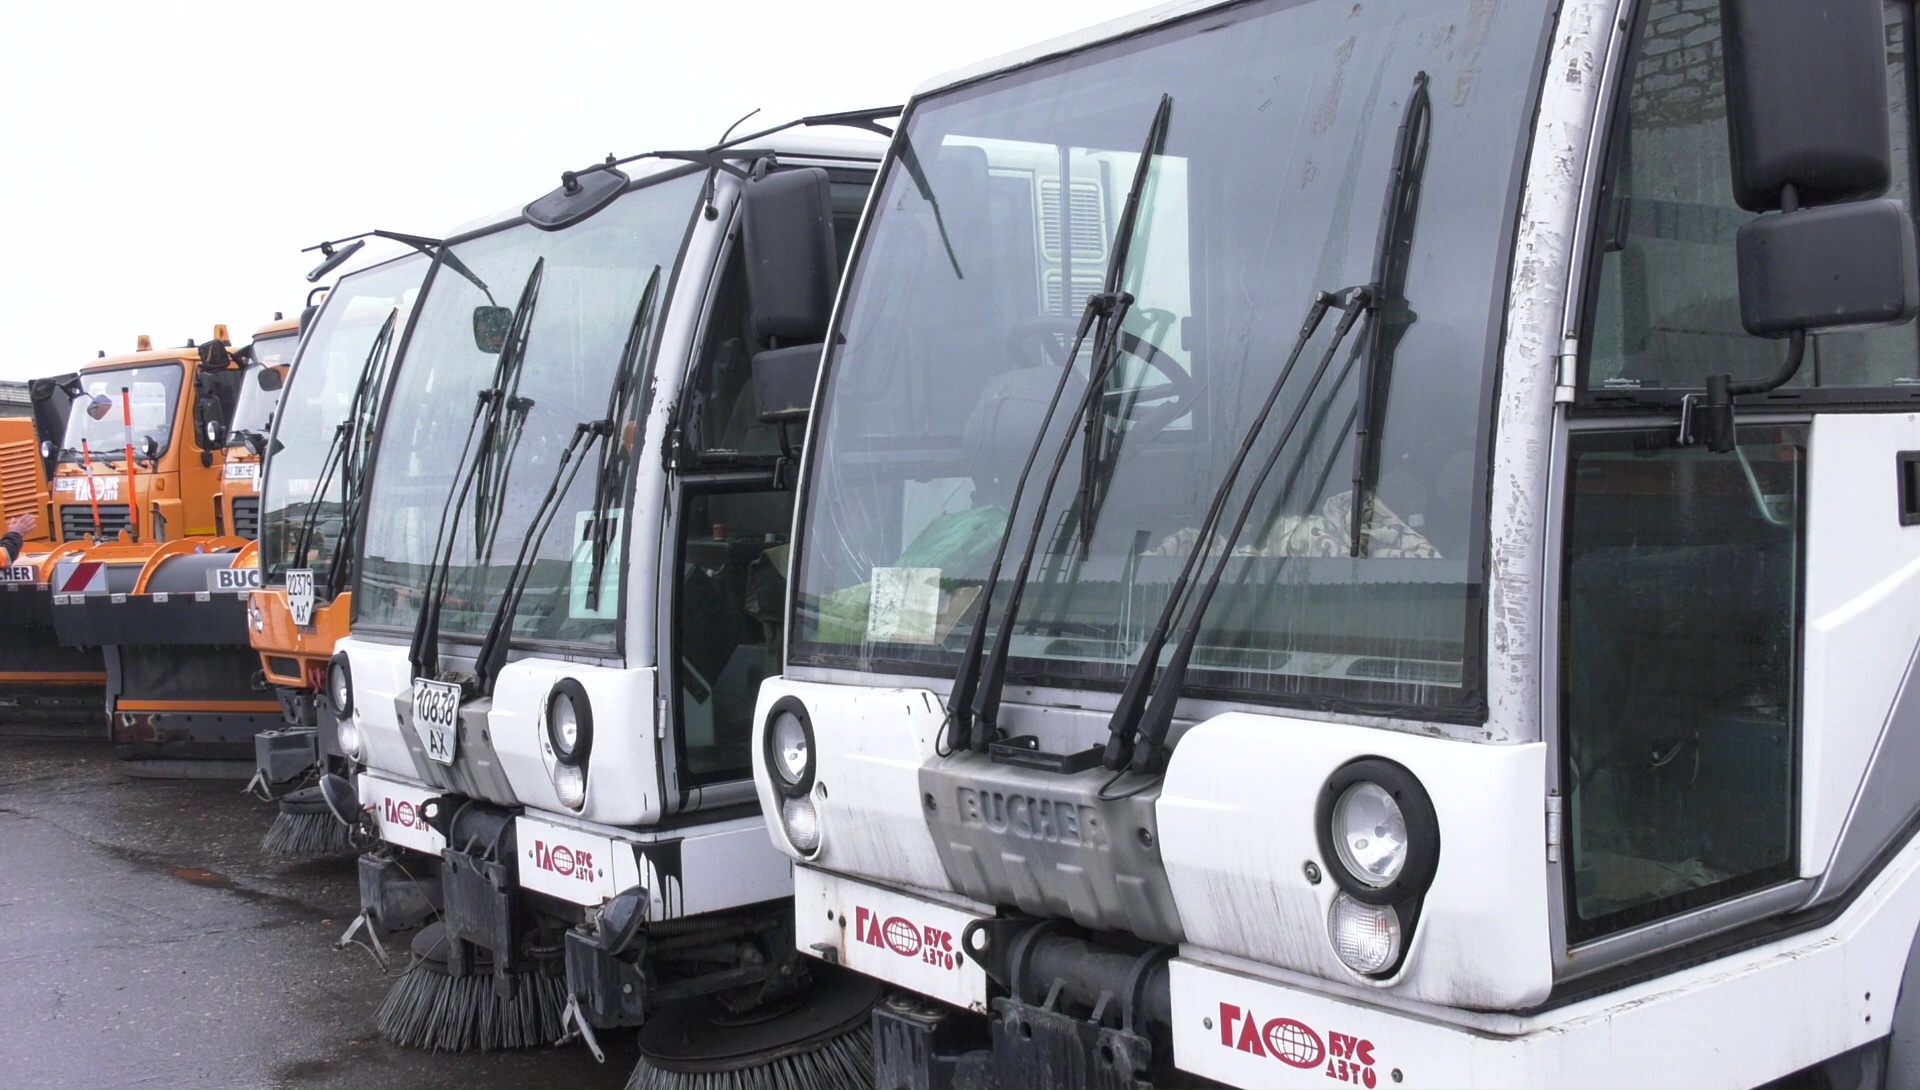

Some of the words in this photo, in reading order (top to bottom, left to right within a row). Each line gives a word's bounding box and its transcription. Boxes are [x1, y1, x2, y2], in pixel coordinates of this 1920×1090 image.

[0, 566, 30, 580] HER
[287, 573, 312, 596] 22379
[416, 688, 455, 727] 10838
[957, 786, 1110, 850] BUCHER
